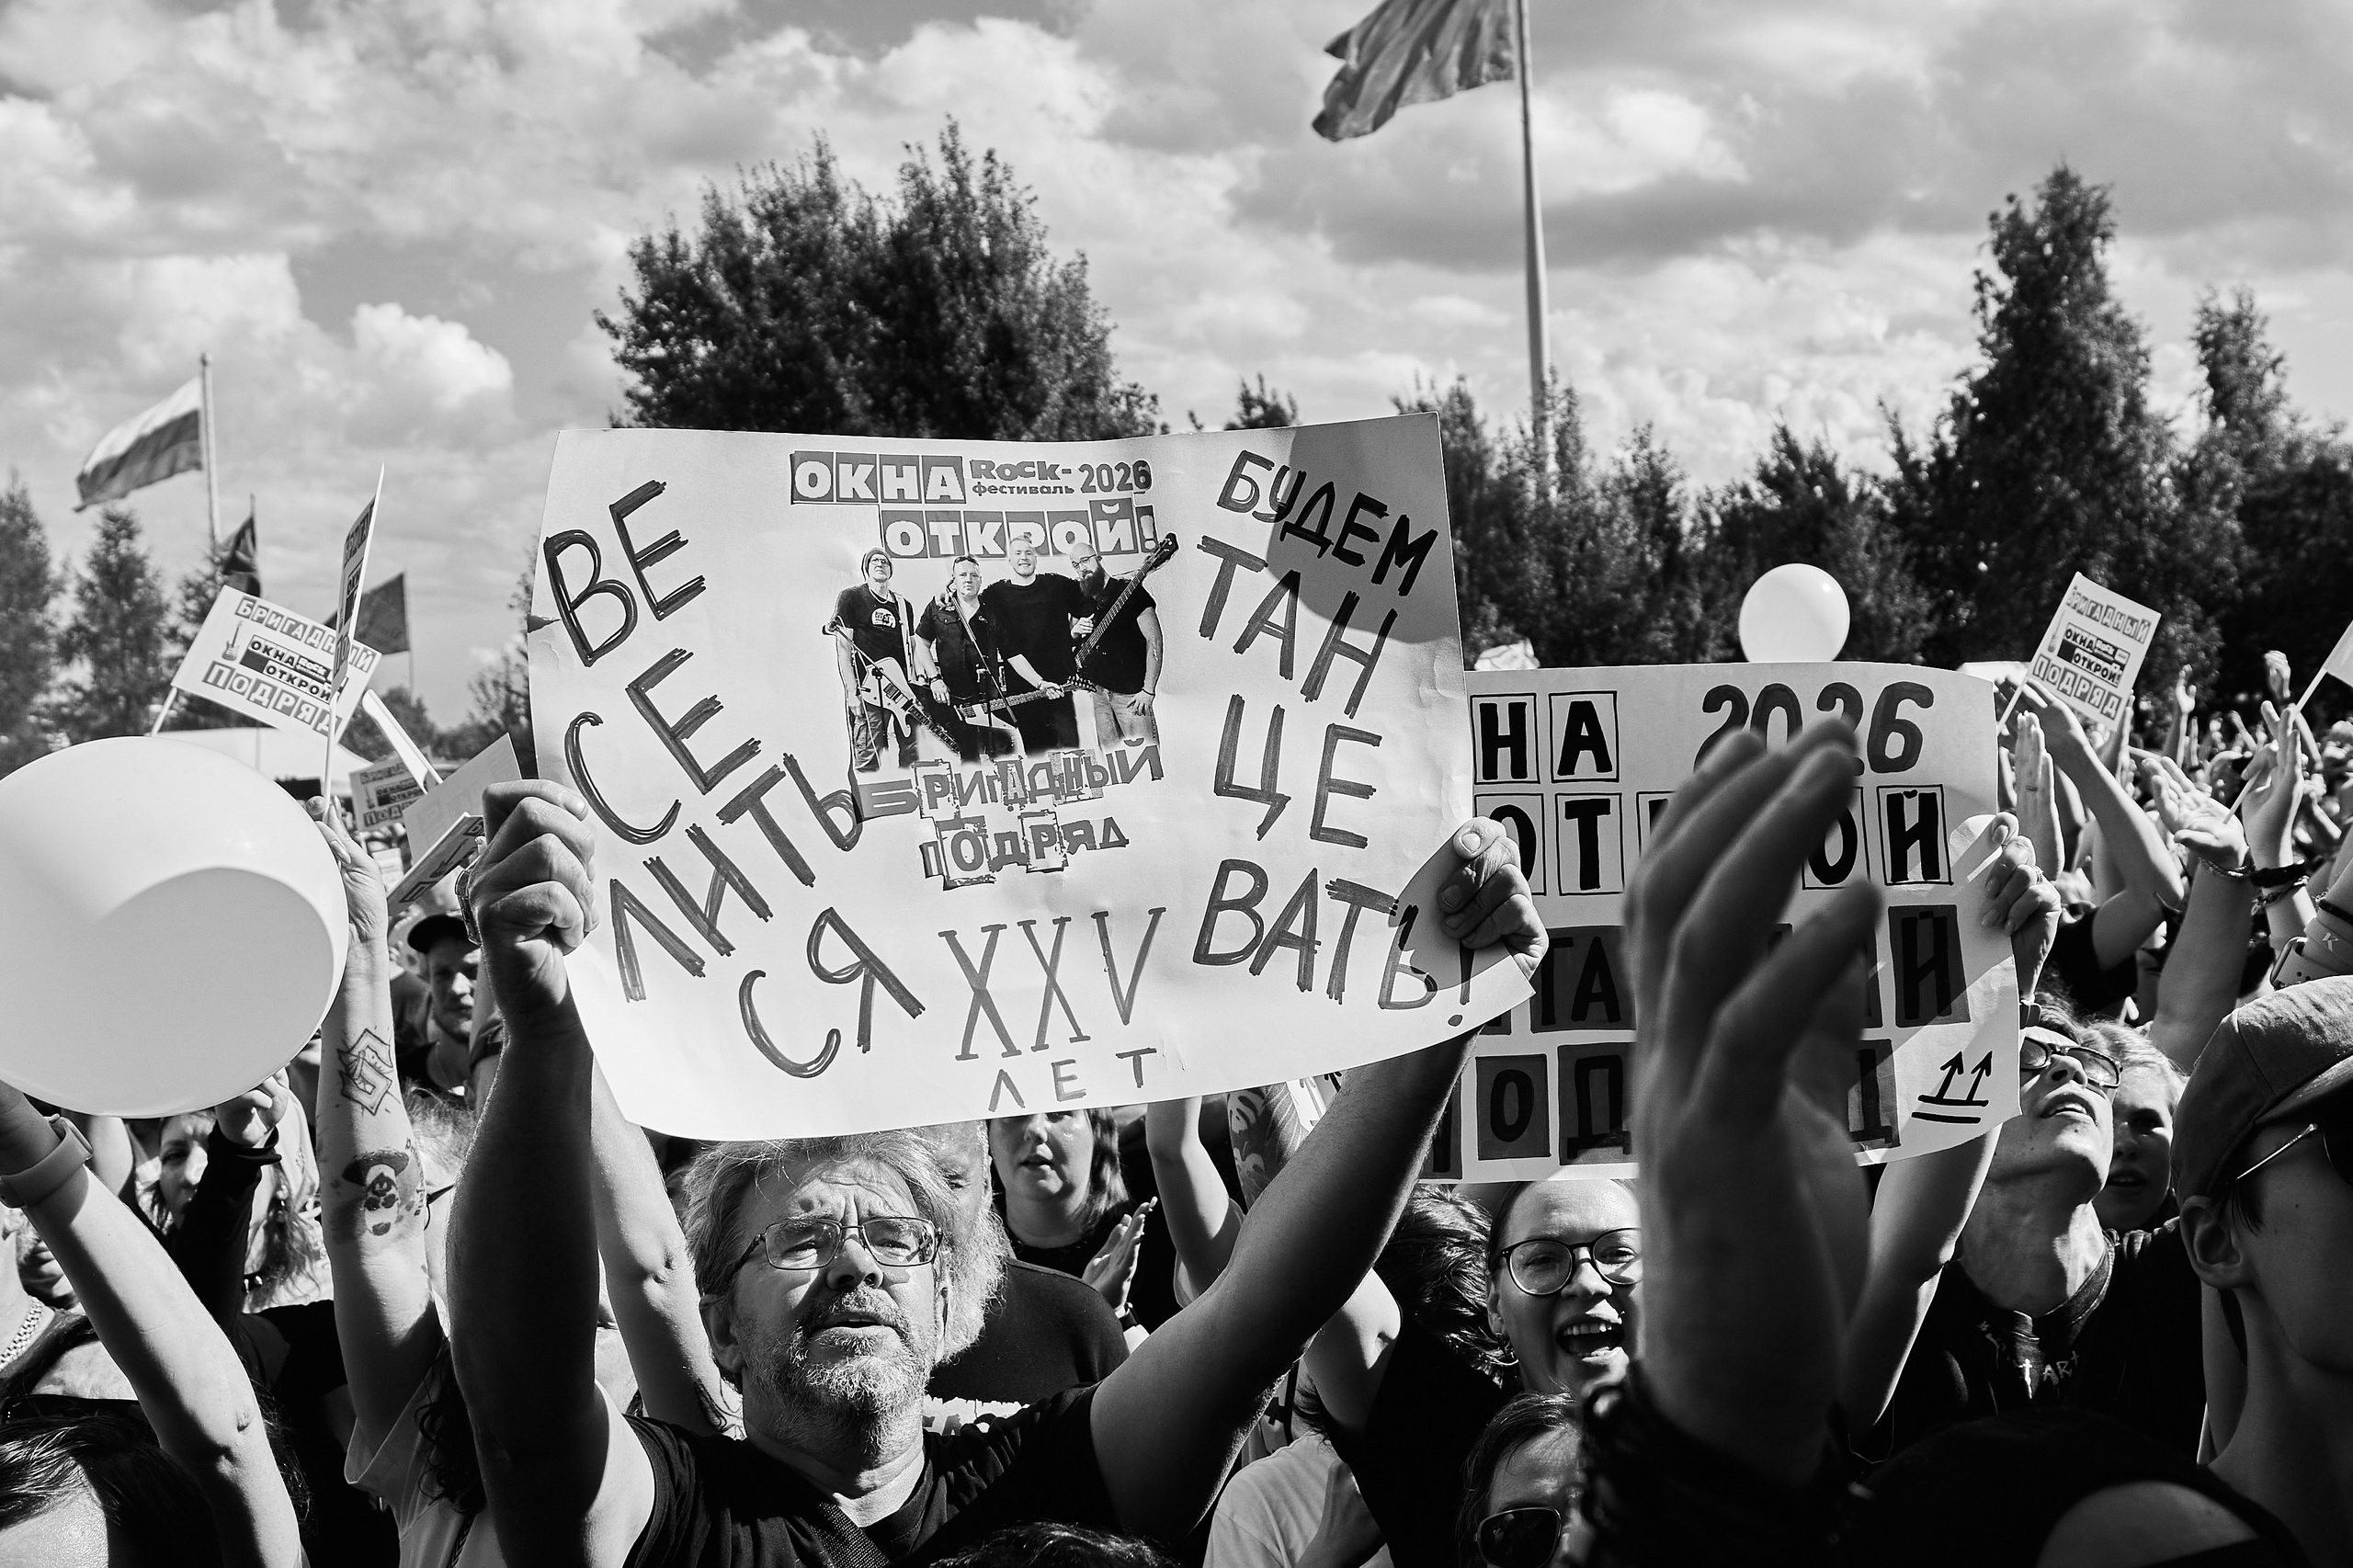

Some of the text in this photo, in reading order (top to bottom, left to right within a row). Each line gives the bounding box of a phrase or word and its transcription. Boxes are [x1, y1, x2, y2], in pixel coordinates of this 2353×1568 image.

[792, 459, 965, 502] ОКНА
[972, 482, 1074, 496] фестиваль
[1078, 460, 1152, 494] 2026
[1217, 450, 1438, 596] БУДЕМ
[542, 479, 705, 666] ВЕ
[1197, 536, 1397, 719] ТАН
[249, 640, 296, 666] ОКНА
[2033, 653, 2121, 720] ПОДРЯД
[2064, 628, 2095, 653] ОКНА
[563, 647, 761, 845] СЕ
[858, 738, 1164, 817] БРИГАДНЫЙ
[1214, 694, 1381, 848] ЦЕ
[609, 753, 864, 1003] ЛИТЬ
[920, 814, 1130, 882] ПОДРЯД
[739, 907, 925, 1078] СЯ
[938, 908, 1165, 1061] XXV
[1193, 858, 1475, 1027] ВАТЬ!
[988, 1048, 1156, 1112] ЛЕТ
